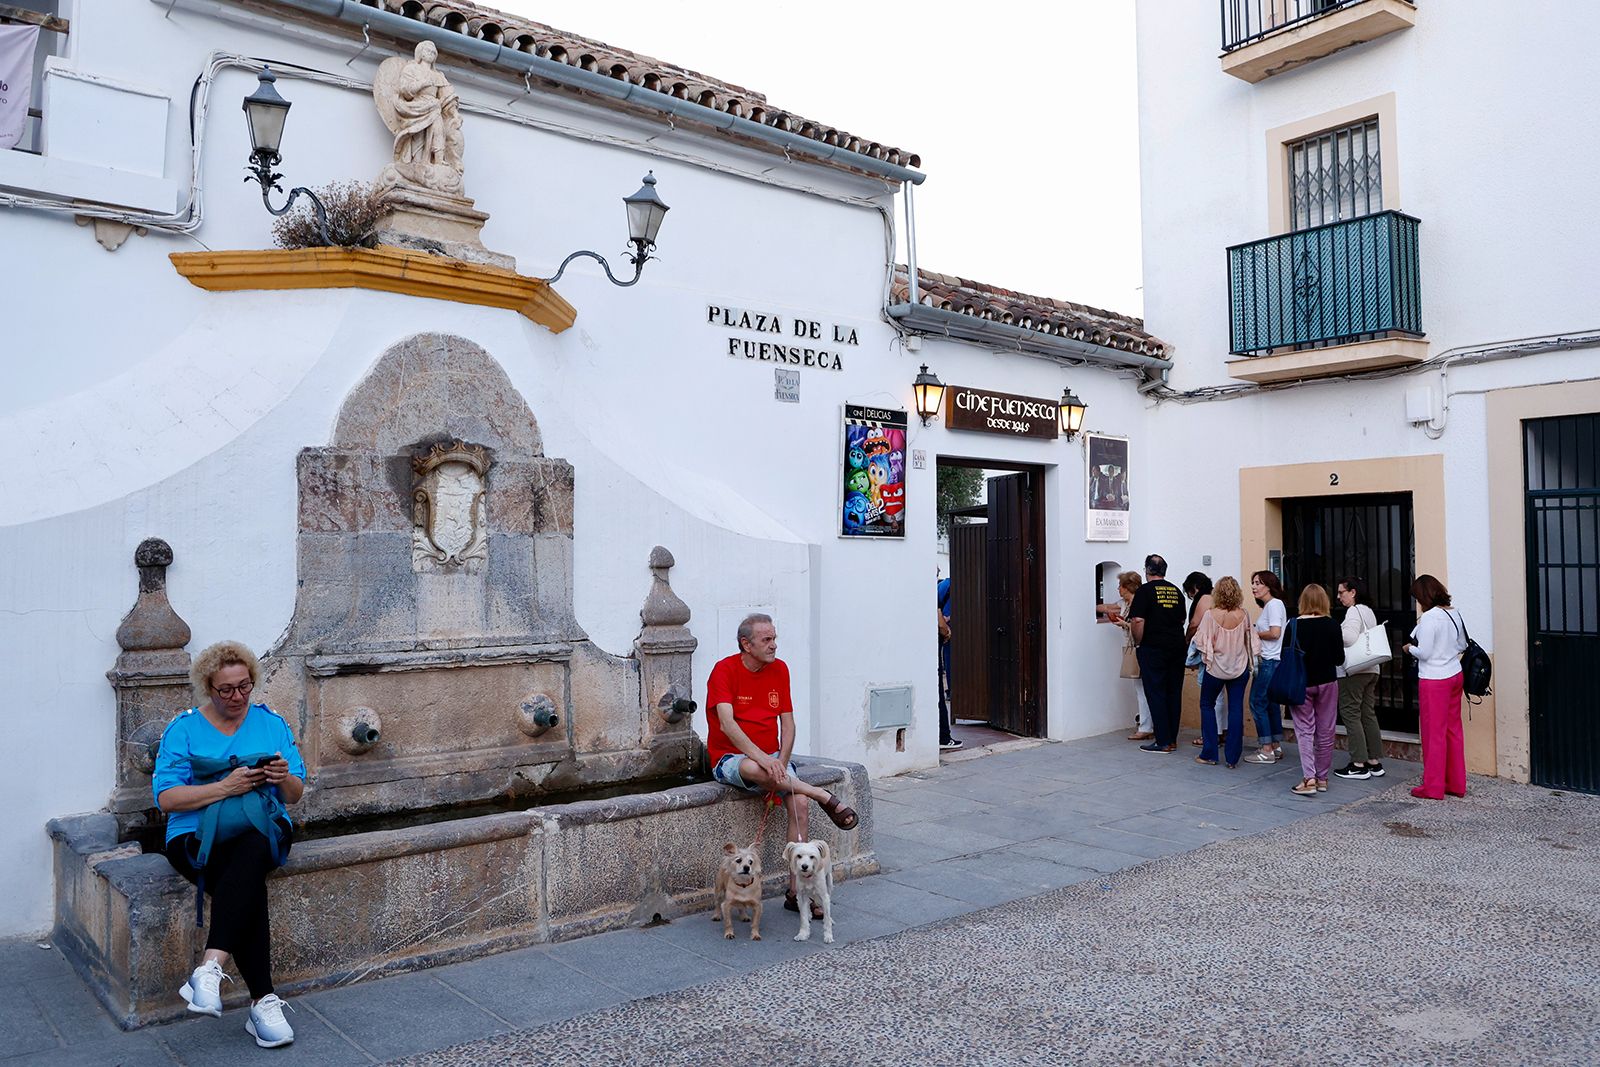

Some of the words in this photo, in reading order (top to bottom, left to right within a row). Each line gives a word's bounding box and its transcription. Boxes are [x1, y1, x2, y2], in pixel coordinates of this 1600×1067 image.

[707, 305, 781, 334] PLAZA
[794, 319, 821, 339] DE
[833, 325, 859, 346] LA
[728, 337, 843, 371] FUENSECA
[853, 409, 863, 417] CINE
[866, 409, 892, 421] DELICIAS
[986, 417, 1011, 430] DESDE
[1329, 473, 1339, 486] 2
[876, 498, 886, 514] 2
